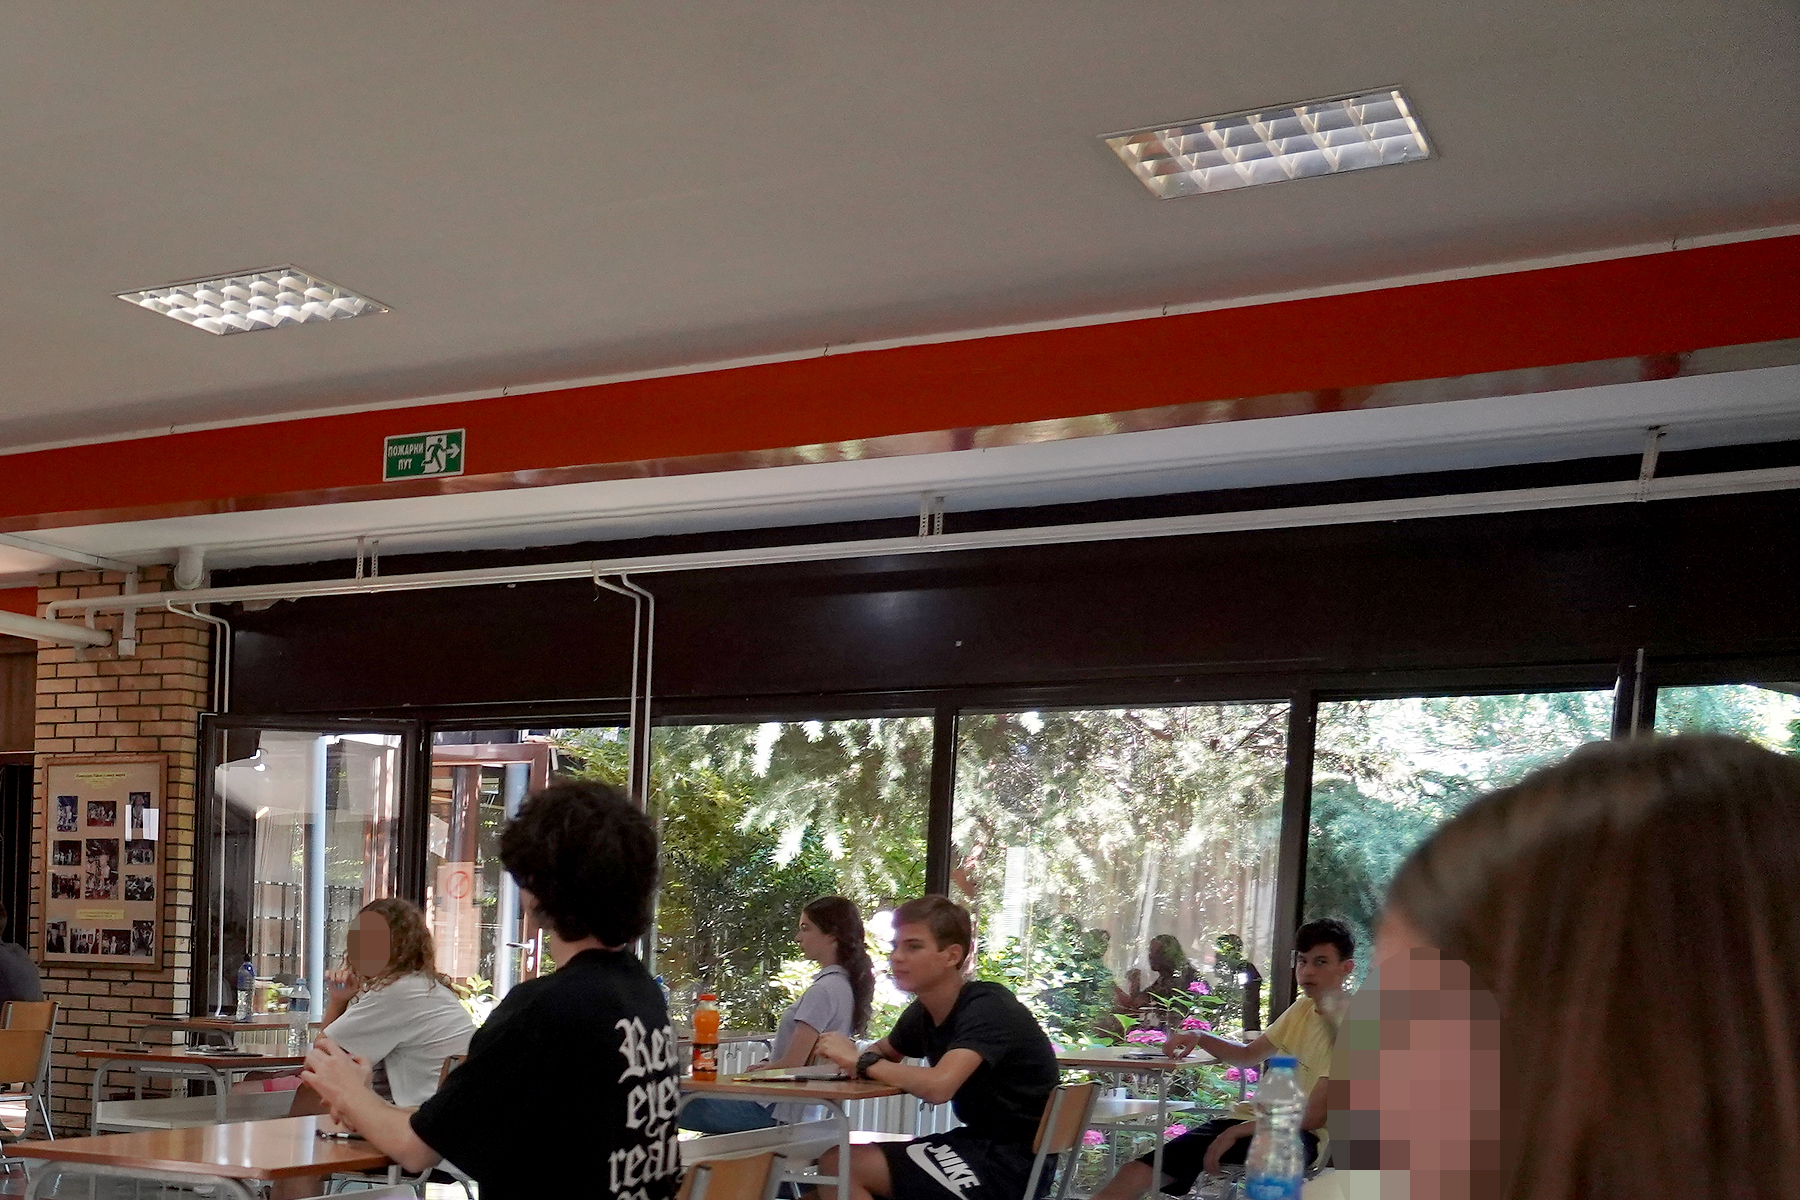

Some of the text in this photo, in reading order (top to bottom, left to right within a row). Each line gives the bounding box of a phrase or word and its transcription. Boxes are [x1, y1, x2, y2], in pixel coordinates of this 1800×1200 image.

[388, 443, 424, 457] ПОЖАРНИ
[398, 458, 413, 471] ПУТ
[614, 1015, 679, 1084] Rea
[927, 1144, 981, 1191] NIKE
